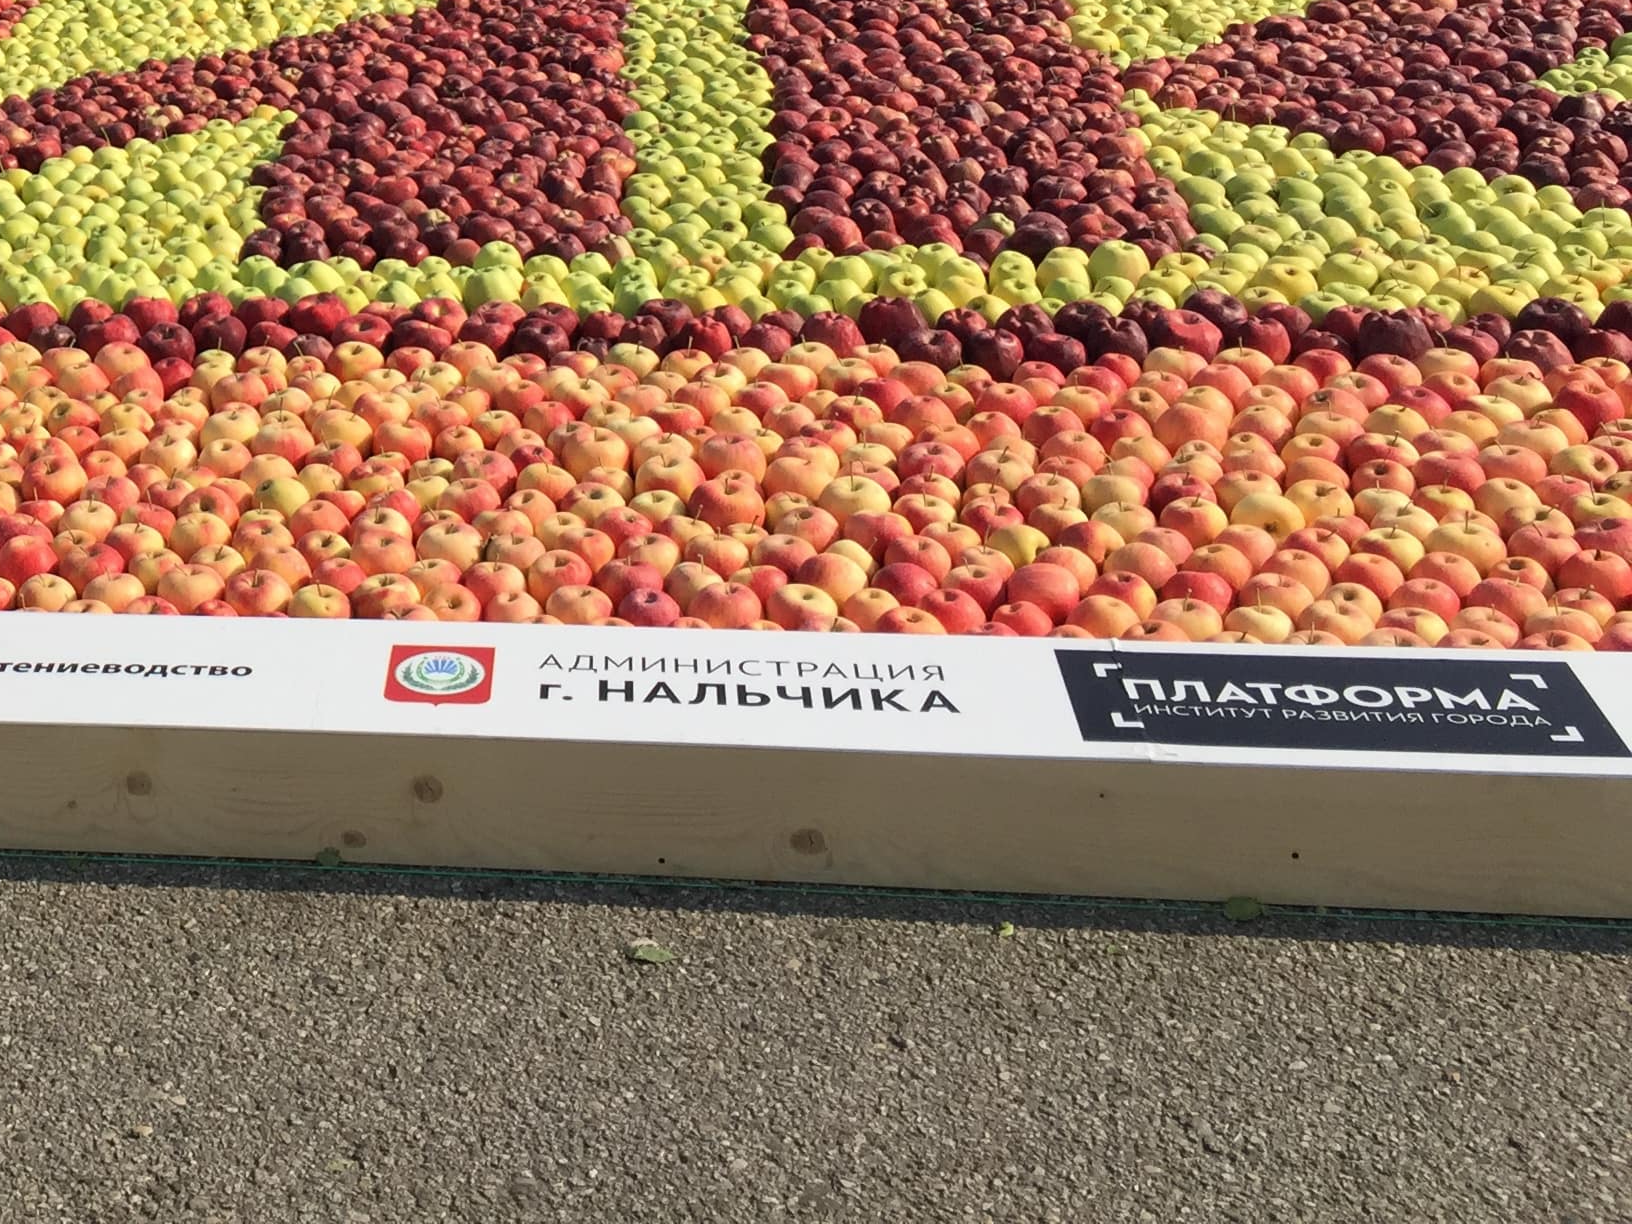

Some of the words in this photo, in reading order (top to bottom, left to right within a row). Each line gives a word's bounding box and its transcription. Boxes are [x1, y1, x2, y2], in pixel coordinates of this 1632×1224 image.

[538, 653, 945, 683] АДМИНИСТРАЦИЯ
[538, 683, 574, 701] г.
[597, 679, 962, 714] НАЛЬЧИКА
[1122, 677, 1541, 712] ПЛАТФОРМА
[1133, 703, 1274, 720] ИНСТИТУТ
[1282, 708, 1425, 725] РАЗВИТИЯ
[1431, 712, 1553, 728] ГОРОДА
